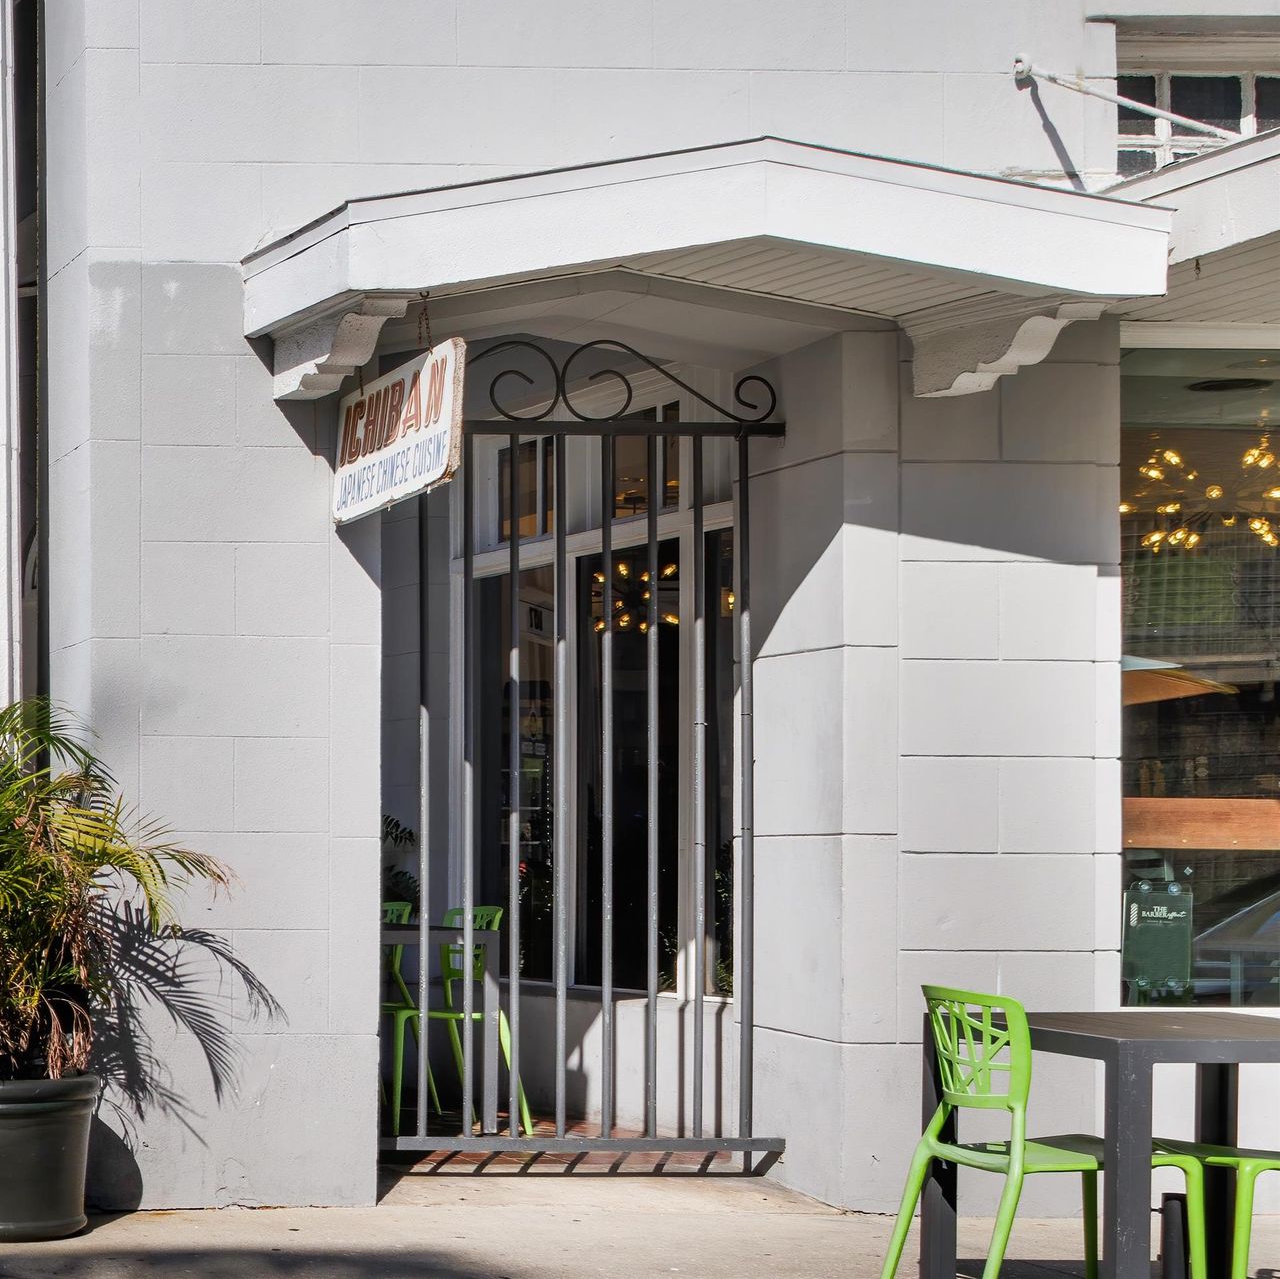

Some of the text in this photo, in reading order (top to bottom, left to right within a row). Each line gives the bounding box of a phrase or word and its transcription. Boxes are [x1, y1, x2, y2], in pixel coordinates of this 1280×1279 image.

[338, 354, 449, 469] ICHIBAN
[336, 429, 448, 512] JAPANESE CHINESE CUISINE
[1152, 905, 1168, 913] THE
